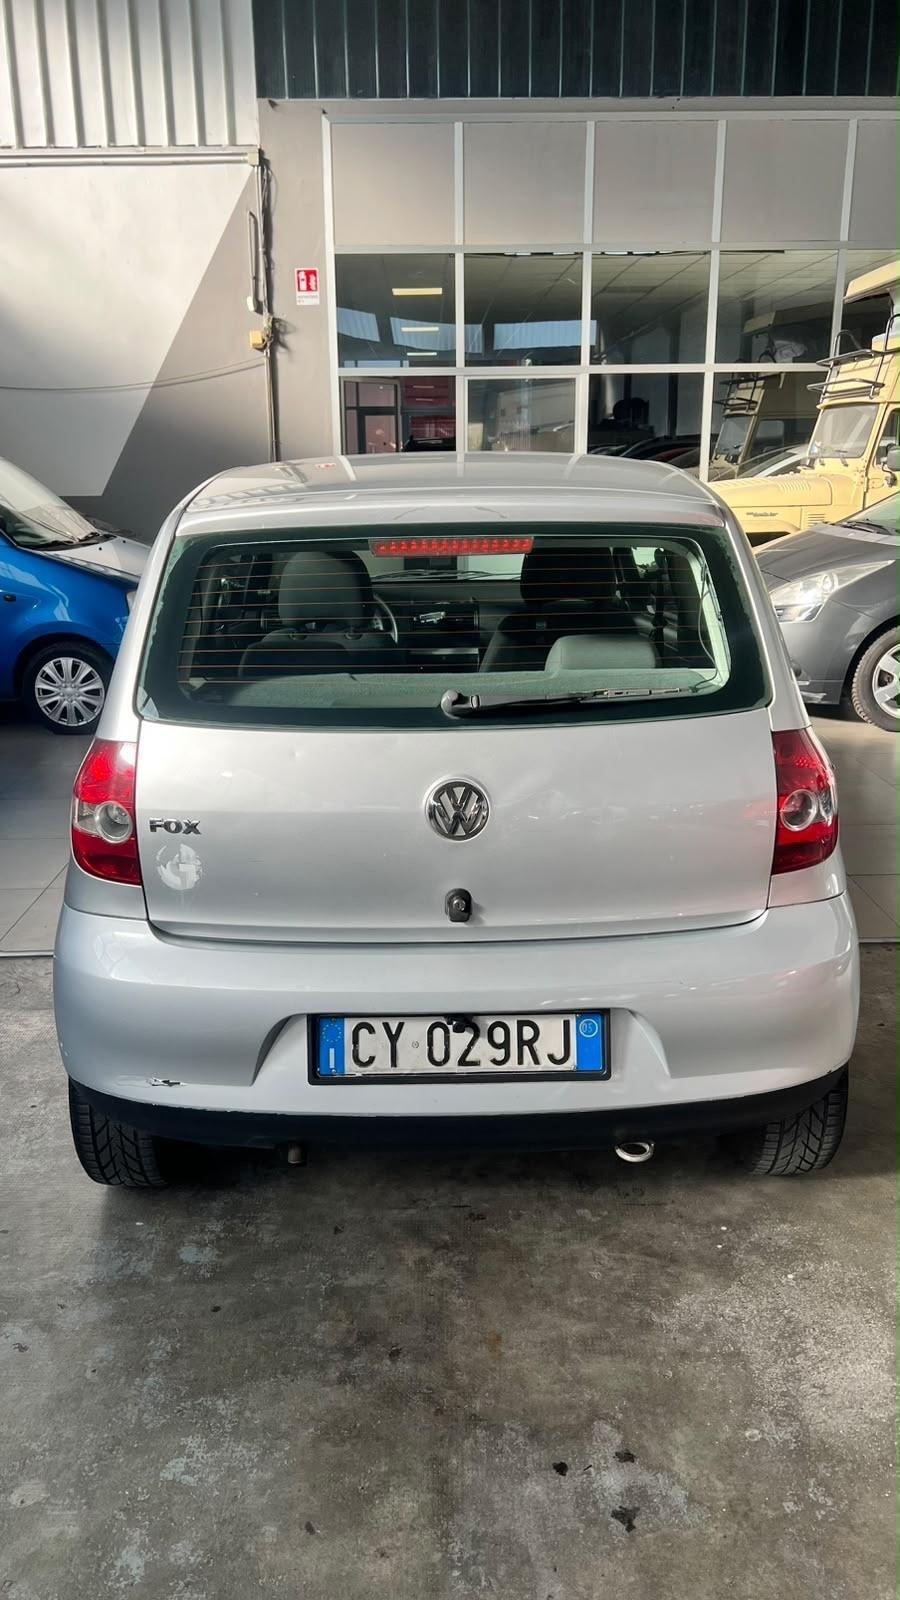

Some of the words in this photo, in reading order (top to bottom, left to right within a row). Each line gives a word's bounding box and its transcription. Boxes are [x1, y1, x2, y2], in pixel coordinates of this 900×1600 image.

[149, 818, 202, 835] FOX
[352, 1021, 405, 1068] CY
[427, 1019, 571, 1067] 029RJ
